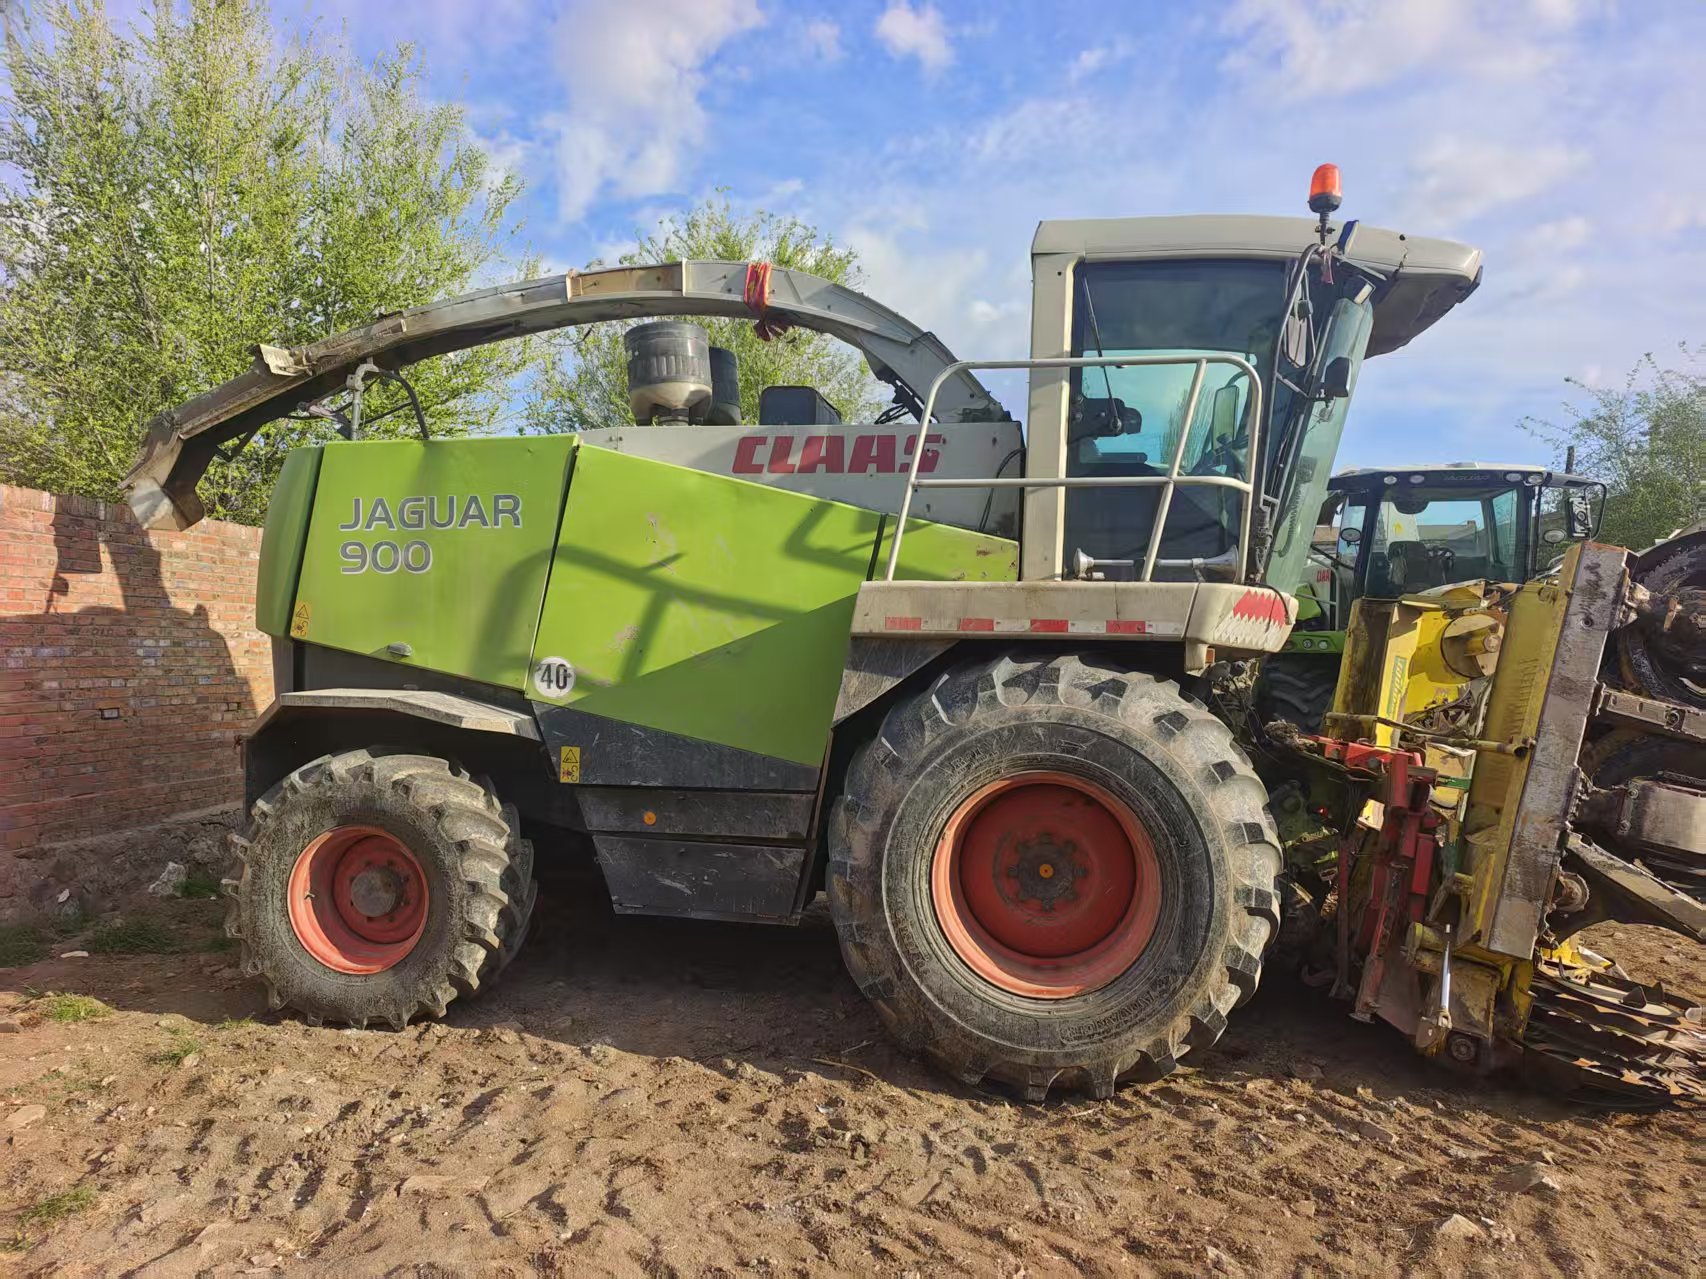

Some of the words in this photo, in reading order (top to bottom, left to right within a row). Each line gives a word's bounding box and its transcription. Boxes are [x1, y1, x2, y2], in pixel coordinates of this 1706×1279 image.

[732, 434, 943, 474] CLAAS
[339, 494, 523, 532] JAGUAR
[339, 540, 433, 575] 900
[540, 663, 568, 690] 40
